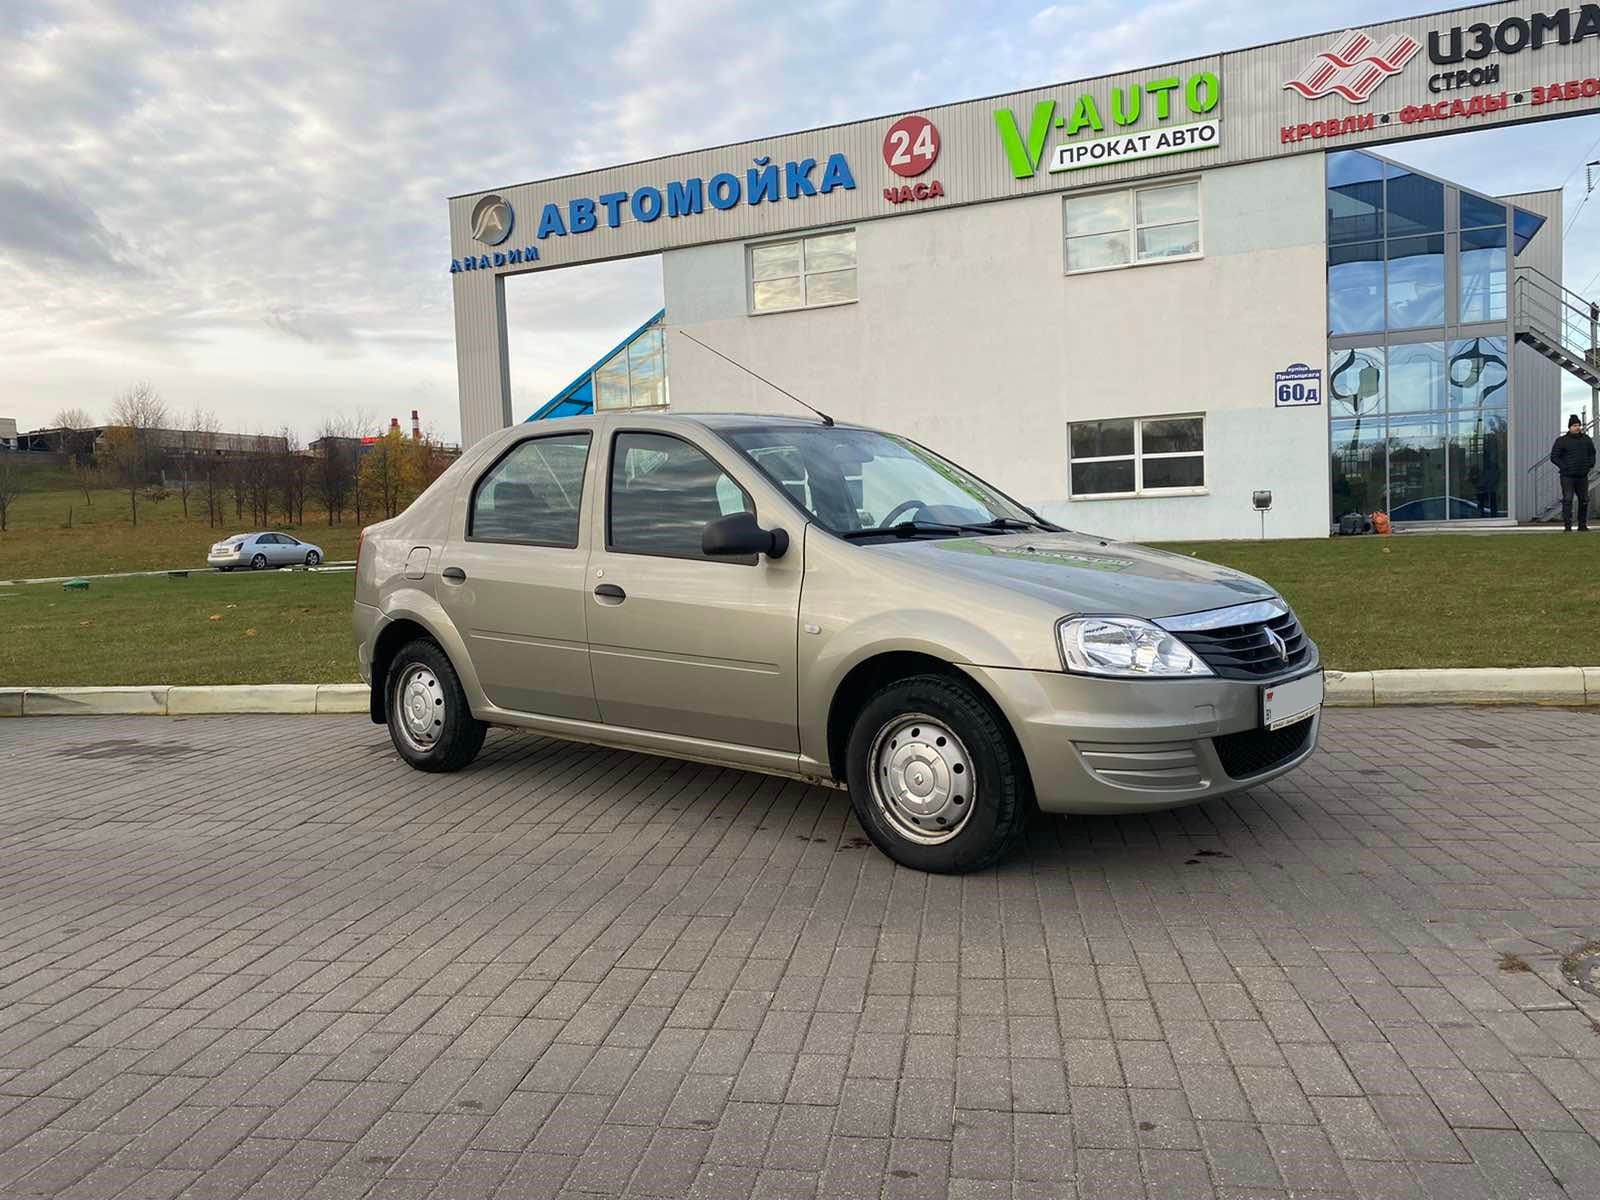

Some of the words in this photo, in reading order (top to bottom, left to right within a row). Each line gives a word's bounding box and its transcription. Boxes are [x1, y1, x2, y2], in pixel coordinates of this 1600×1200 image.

[1428, 64, 1500, 93] СТРОЙ
[1280, 113, 1375, 144] КРОВЛИ
[1399, 91, 1507, 124] ФАСАДЫ
[890, 124, 935, 166] 24
[1059, 135, 1151, 165] ПРОКАТ
[1156, 125, 1216, 150] АВТО
[537, 153, 856, 240] АВТОМОЙКА
[884, 180, 945, 205] ЧАСА
